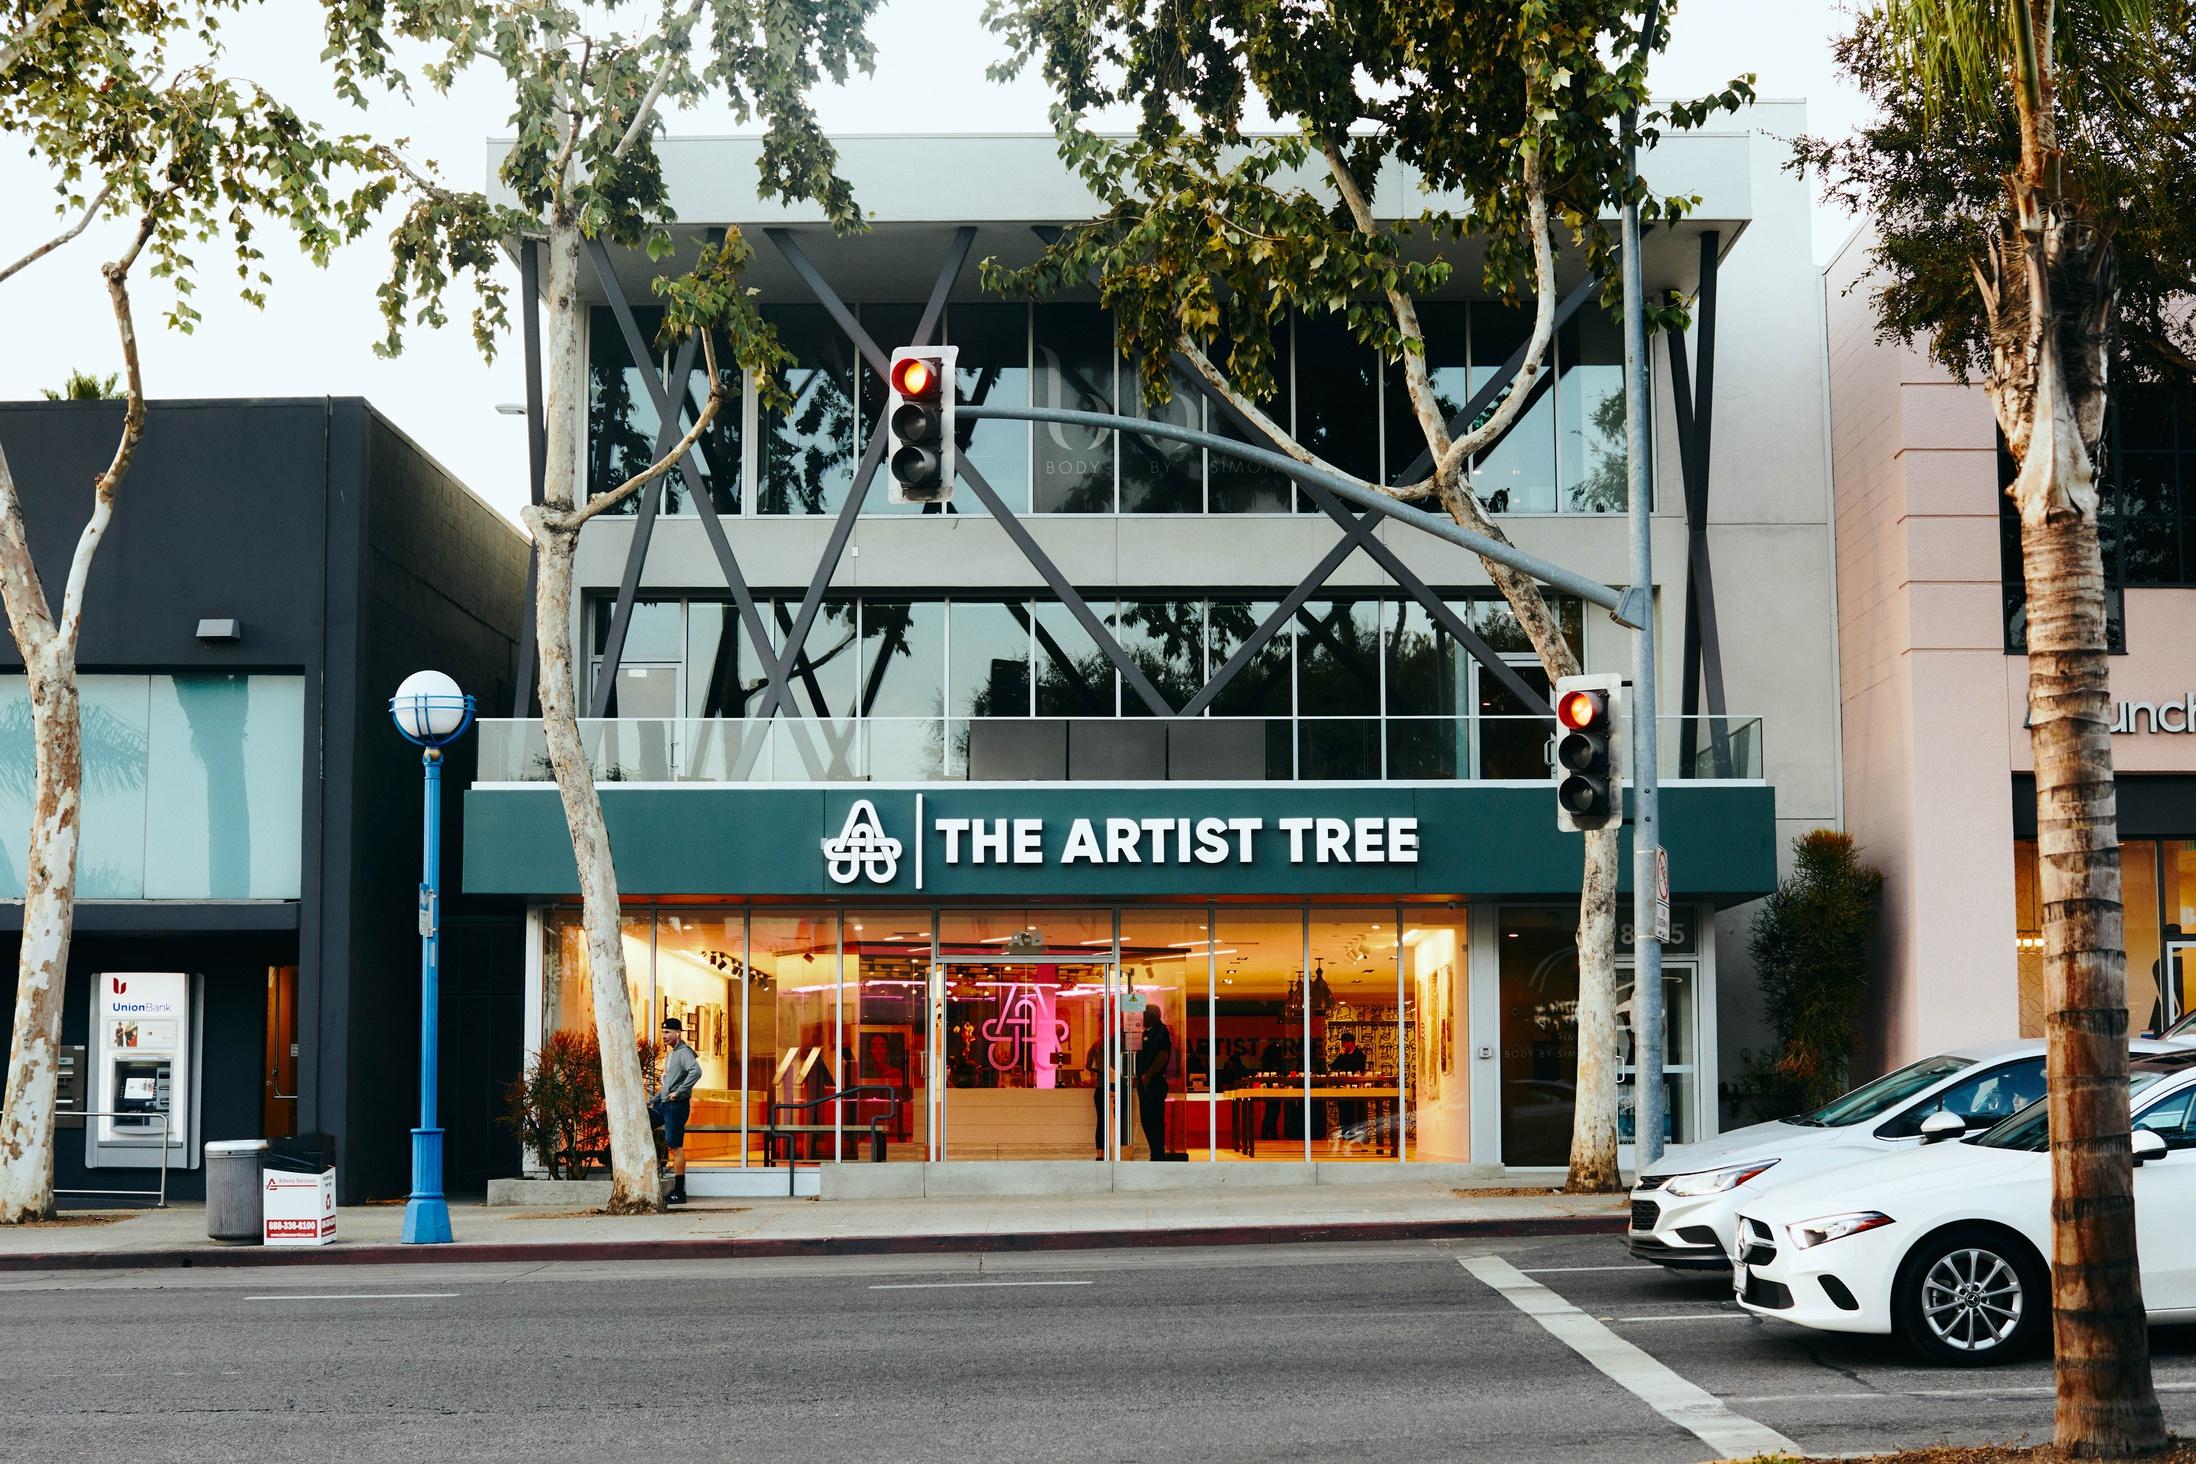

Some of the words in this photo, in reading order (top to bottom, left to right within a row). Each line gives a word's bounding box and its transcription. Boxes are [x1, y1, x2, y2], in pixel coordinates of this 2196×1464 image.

[1046, 460, 1100, 475] BODY
[1151, 461, 1173, 475] BY
[936, 818, 1043, 863] THE
[1061, 818, 1262, 863] ARTIST
[1280, 818, 1418, 863] TREE
[112, 1002, 172, 1012] UnionBank
